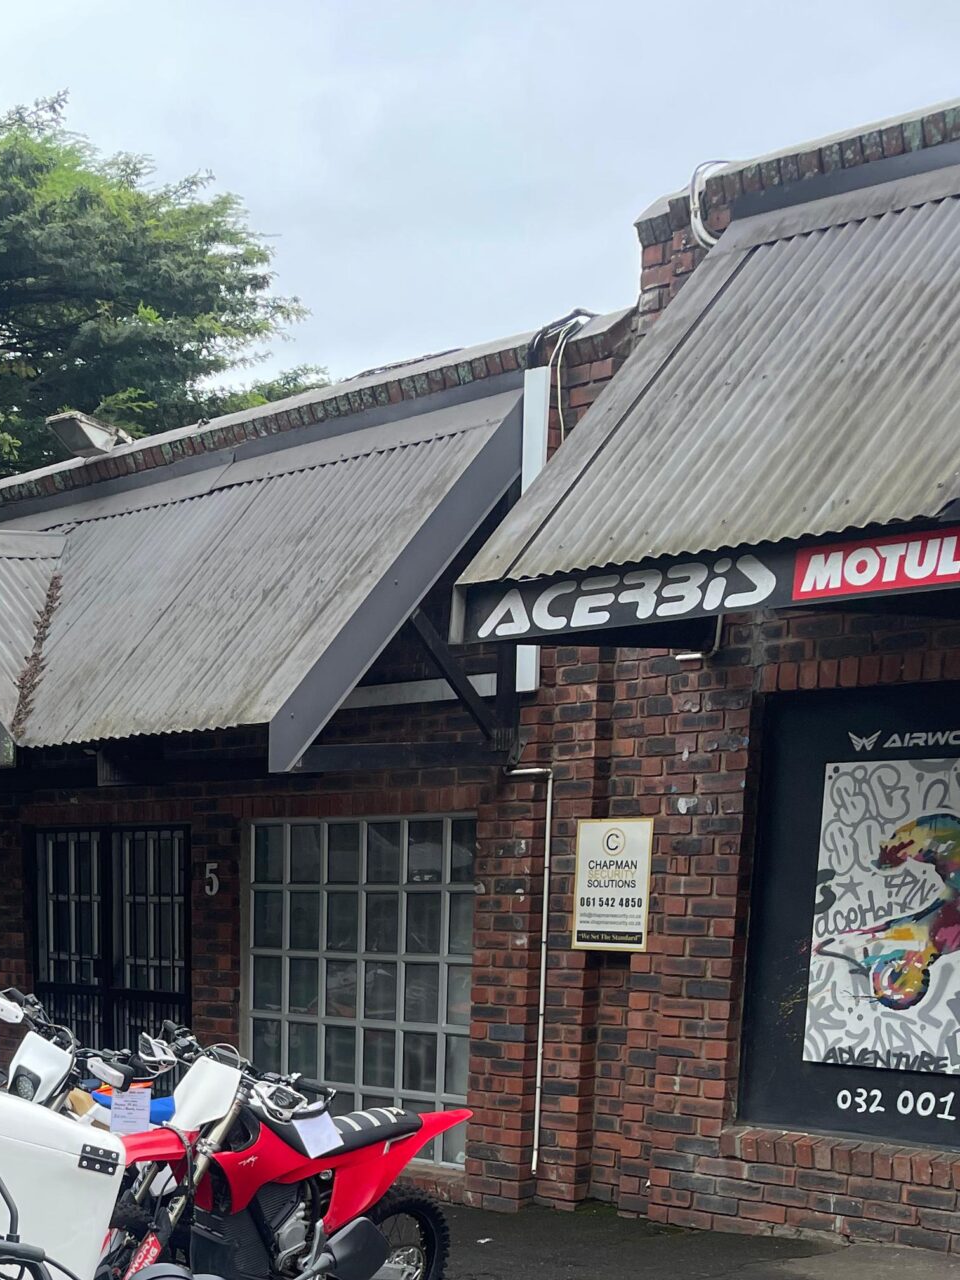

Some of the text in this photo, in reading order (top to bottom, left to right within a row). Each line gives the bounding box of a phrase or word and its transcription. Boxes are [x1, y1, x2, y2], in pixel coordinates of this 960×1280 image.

[800, 536, 960, 593] MOTUL
[588, 860, 638, 870] CHAPMAN
[205, 862, 219, 896] 5
[588, 869, 637, 880] SECURITY
[587, 879, 637, 889] SOLUTIONS
[580, 897, 643, 908] 061 542 4850
[836, 1087, 957, 1121] 032 001
